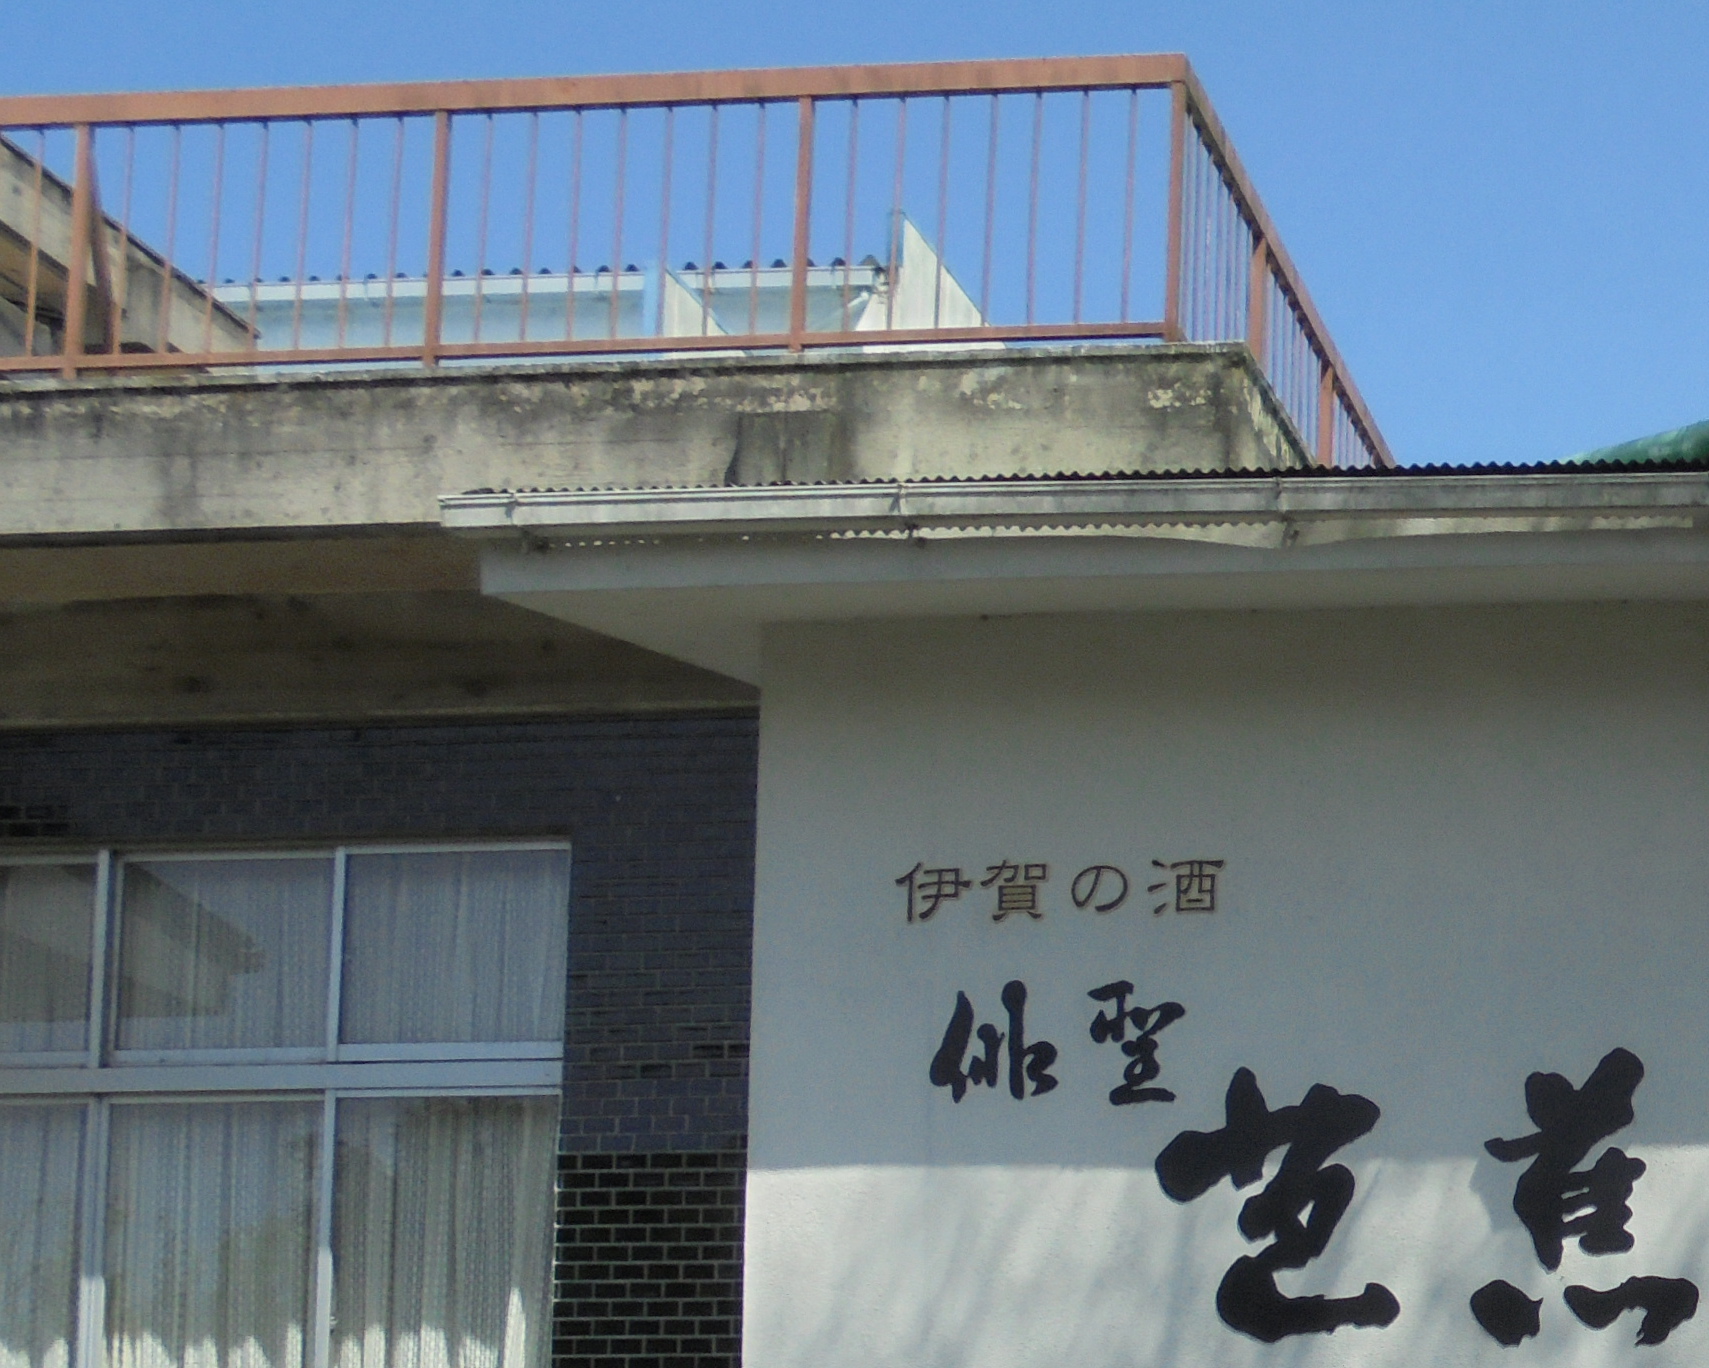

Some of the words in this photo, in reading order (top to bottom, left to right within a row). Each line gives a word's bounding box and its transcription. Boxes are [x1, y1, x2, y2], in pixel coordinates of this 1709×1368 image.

[895, 859, 1226, 924] 伊賀の酒
[1155, 1046, 1700, 1348] 芭蕉
